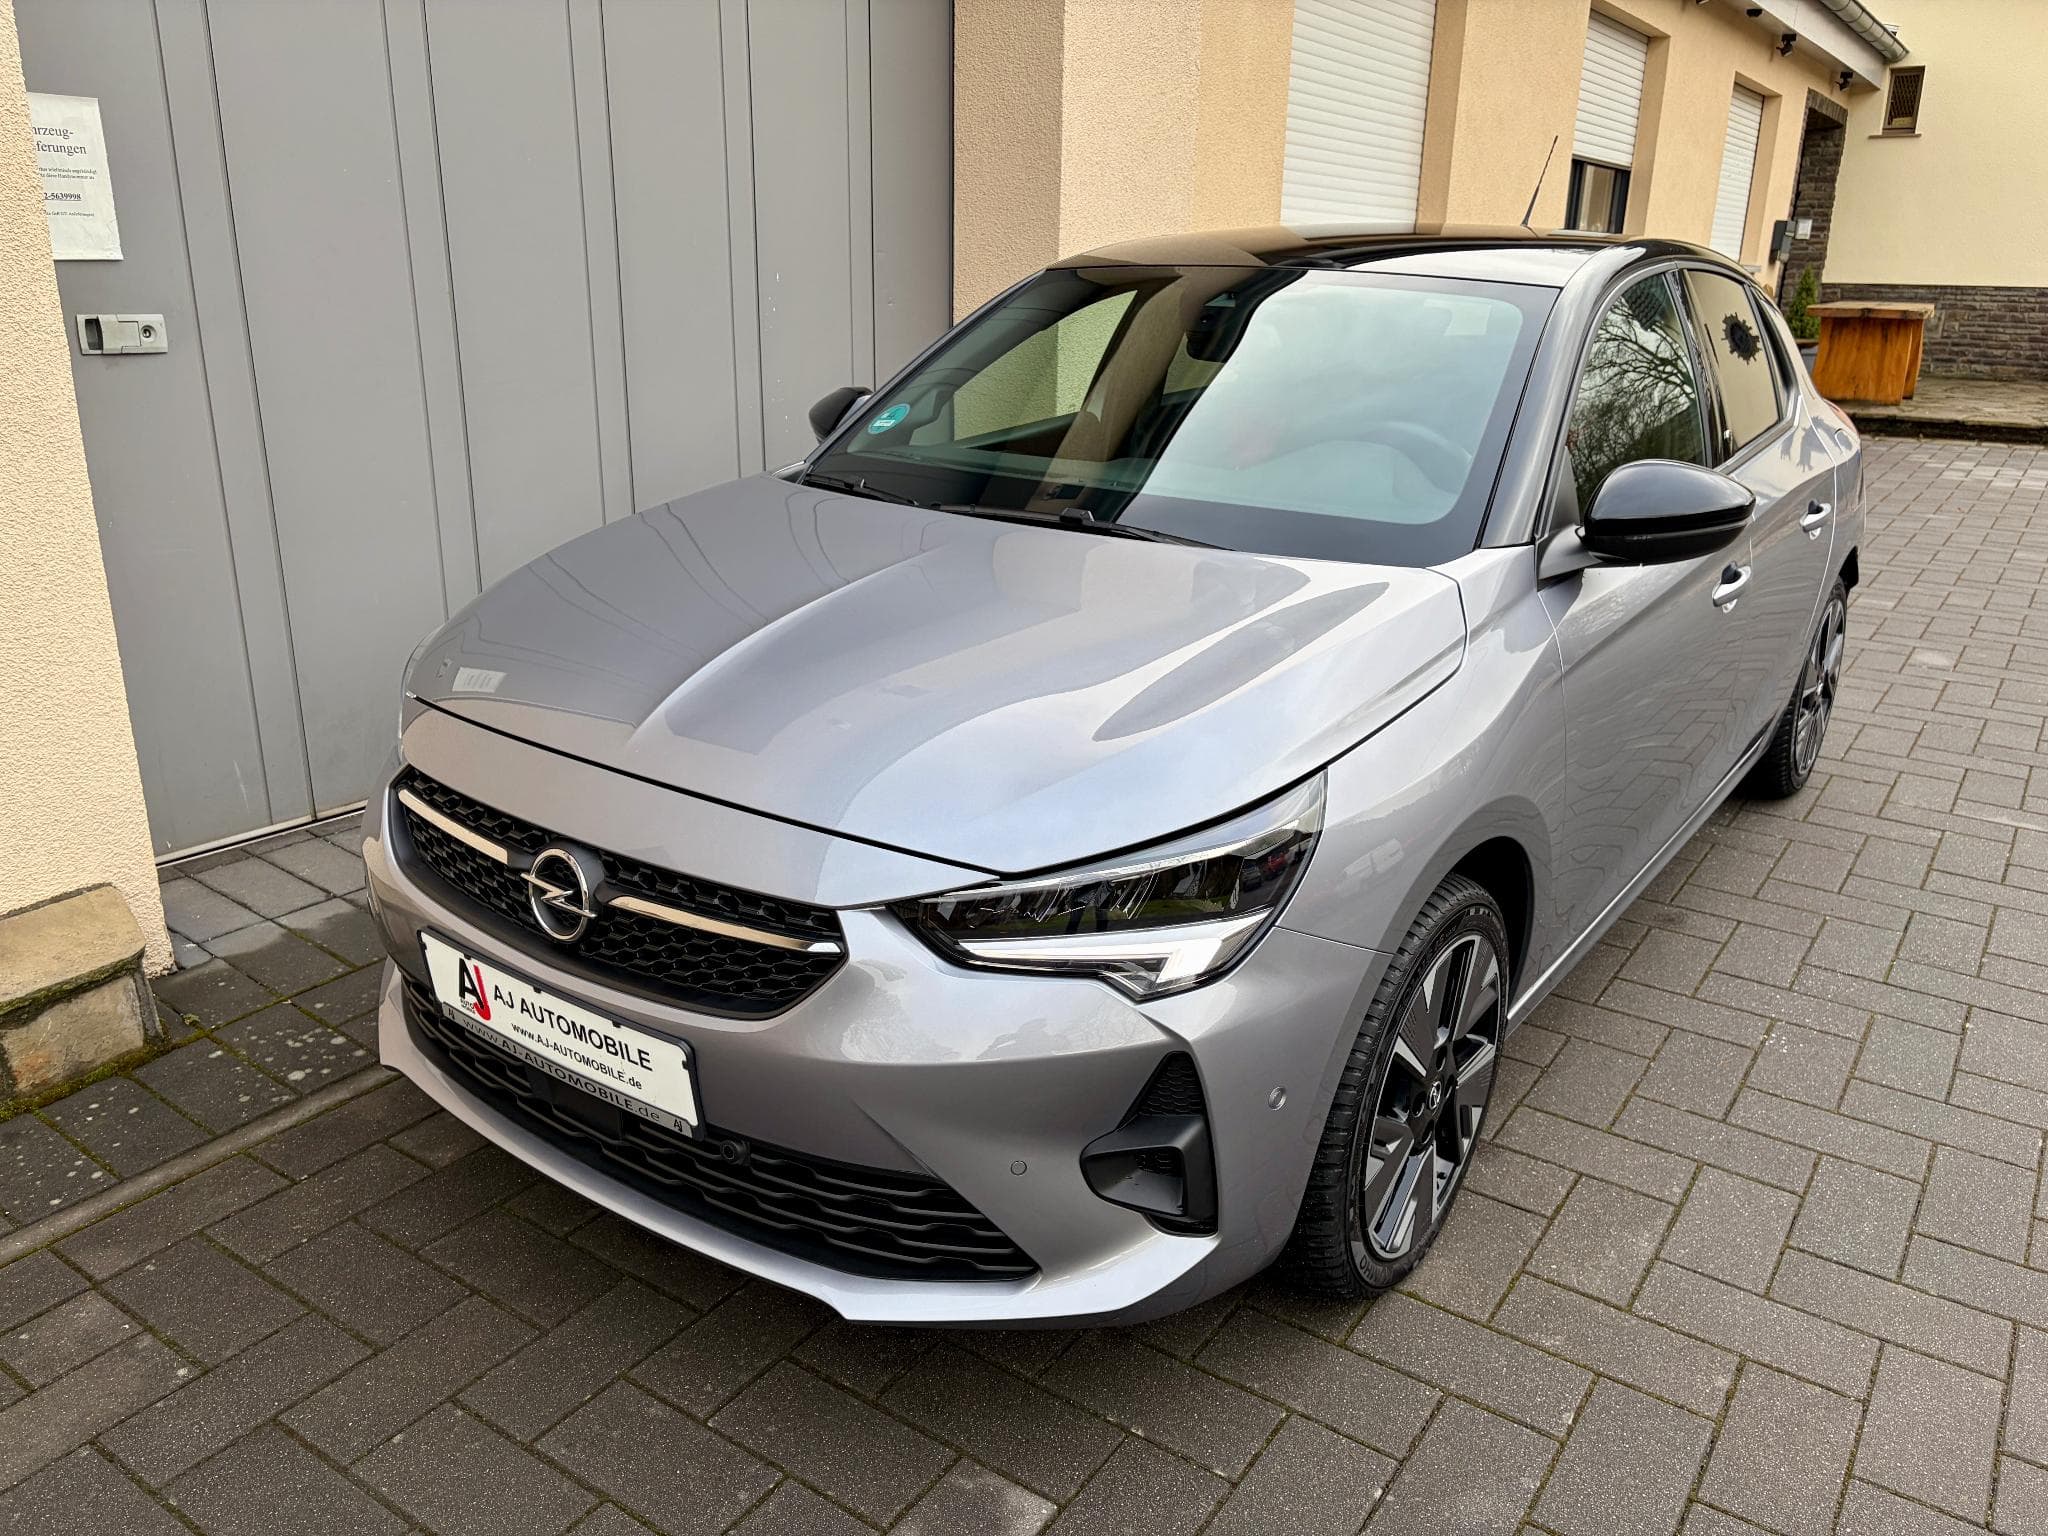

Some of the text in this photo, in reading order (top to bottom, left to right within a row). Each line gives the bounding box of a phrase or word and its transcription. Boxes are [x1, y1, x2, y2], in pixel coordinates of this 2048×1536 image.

[493, 984, 654, 1072] AJ AUTOMOBILE
[511, 1022, 643, 1090] www.AJ-AUTOMOBILE.de
